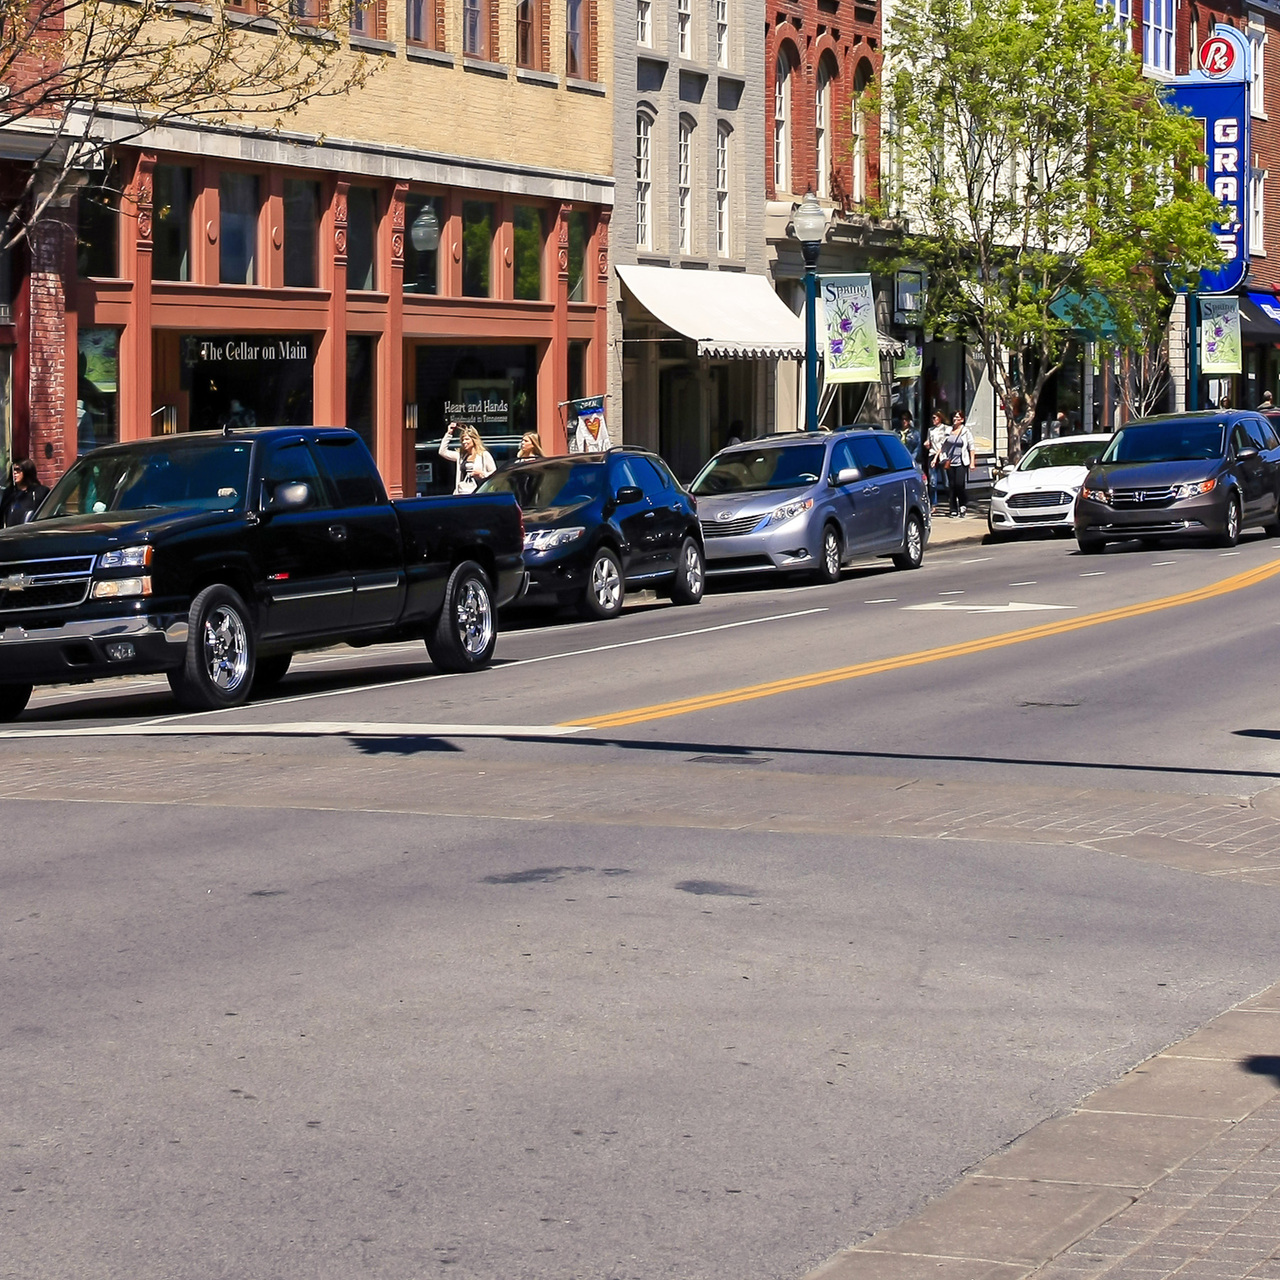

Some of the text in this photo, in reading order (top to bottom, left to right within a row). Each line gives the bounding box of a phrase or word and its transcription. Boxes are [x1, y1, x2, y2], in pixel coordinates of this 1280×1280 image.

[825, 281, 867, 303] Spring
[201, 341, 307, 361] The Cellar on Main
[444, 399, 508, 414] Heart and Hands
